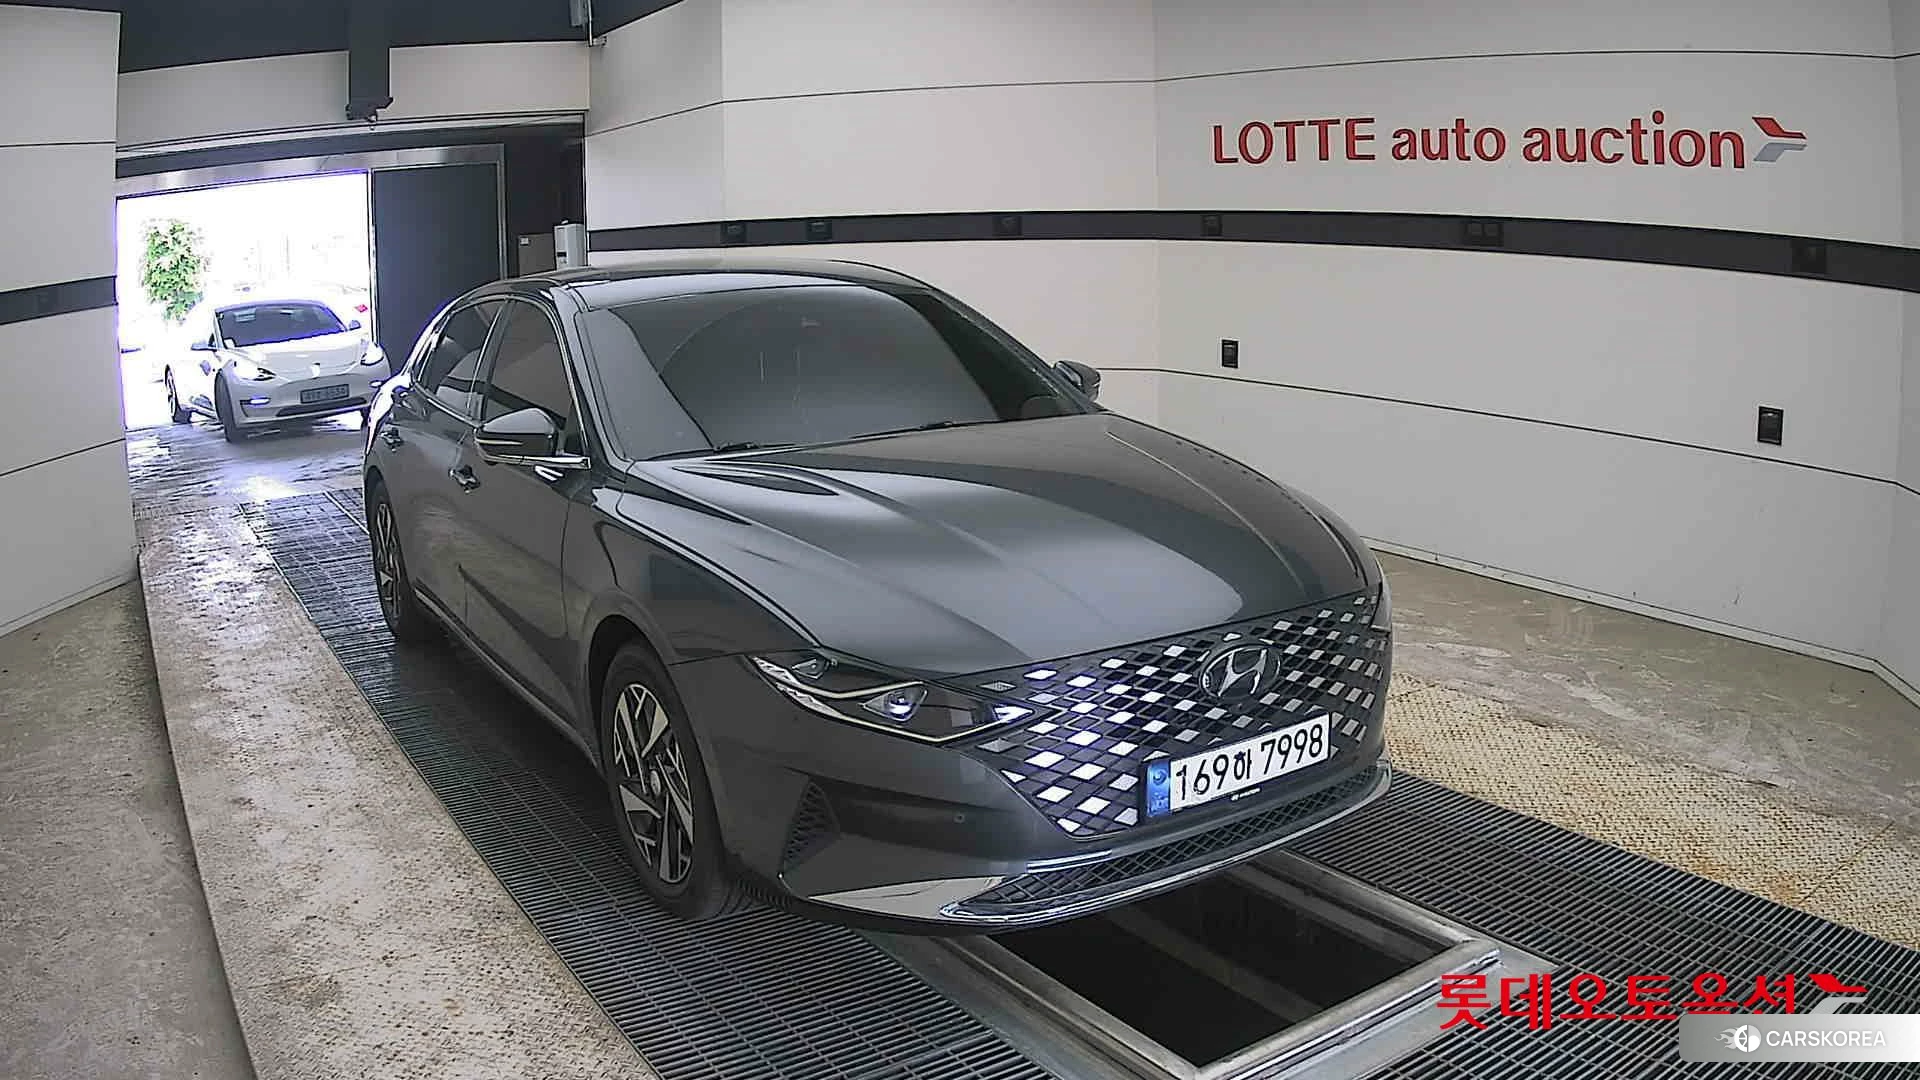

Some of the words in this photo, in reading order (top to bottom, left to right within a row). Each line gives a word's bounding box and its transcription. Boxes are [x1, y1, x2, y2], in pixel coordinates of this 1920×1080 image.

[1212, 117, 1376, 164] LOTTE
[1391, 118, 1507, 162] auto
[1522, 111, 1746, 169] auction
[1175, 748, 1253, 800] 169하
[1260, 723, 1324, 775] 7998
